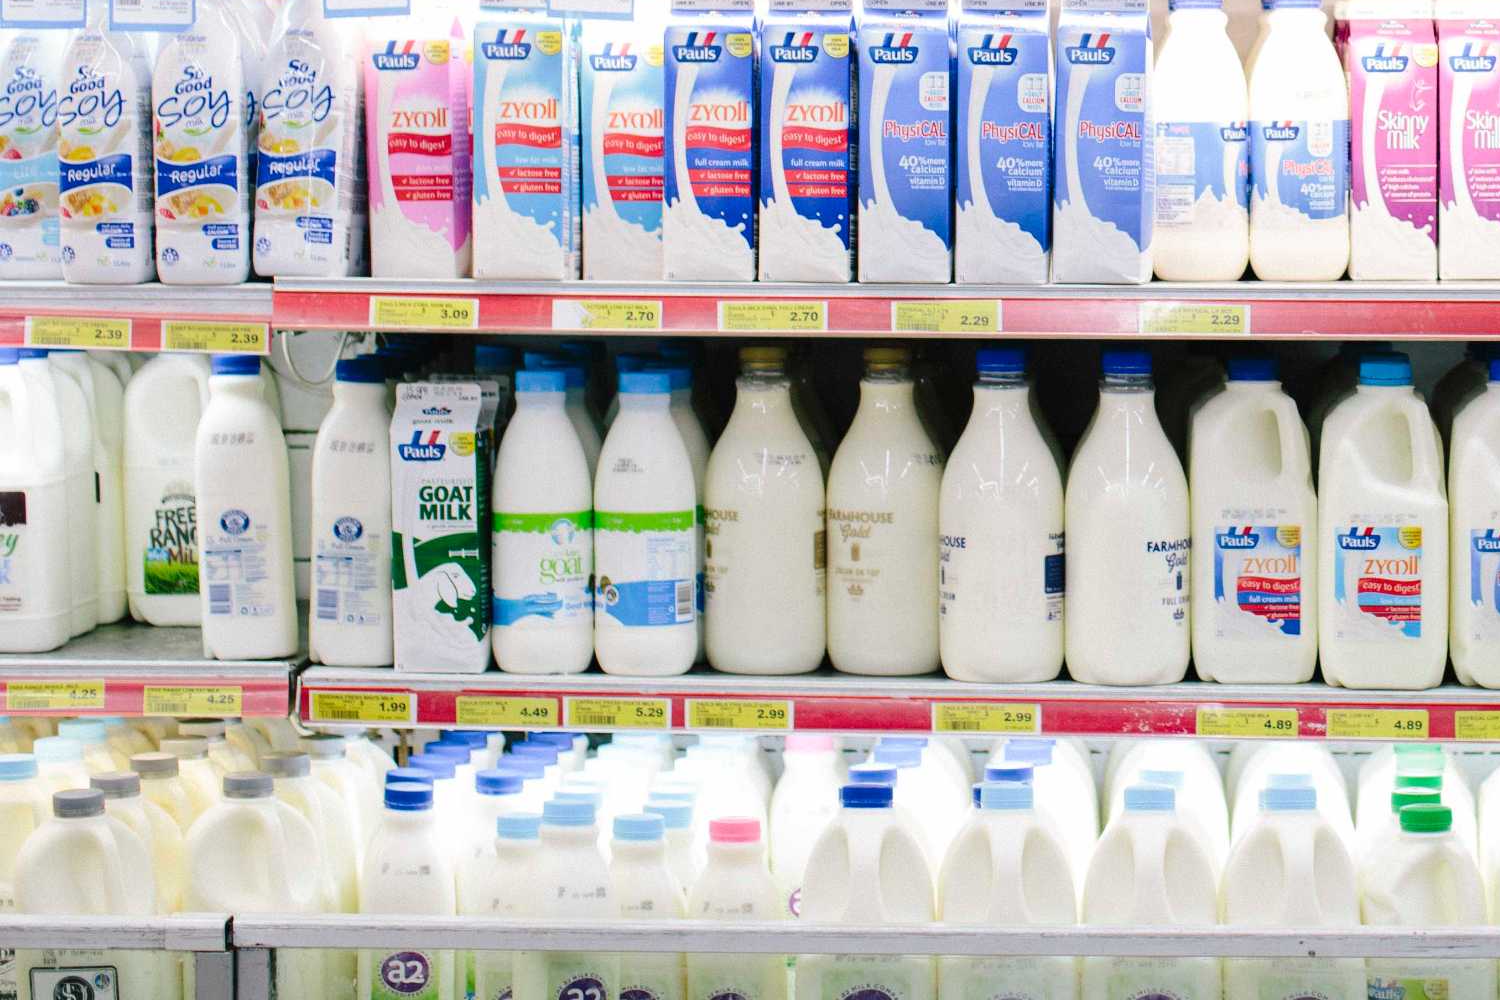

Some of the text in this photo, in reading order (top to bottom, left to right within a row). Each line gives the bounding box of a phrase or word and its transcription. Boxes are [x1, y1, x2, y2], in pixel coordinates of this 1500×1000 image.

[175, 78, 212, 95] Good
[1378, 108, 1429, 134] Skinny
[884, 121, 946, 140] PhysiCAL
[1079, 121, 1141, 141] PhysiCAL
[1386, 127, 1421, 150] Milk
[694, 158, 706, 167] full
[731, 158, 748, 166] milk
[68, 164, 116, 182] Regular
[171, 165, 222, 184] Regular
[441, 309, 468, 320] 3.09
[626, 310, 654, 322] 2.70
[790, 311, 818, 322] 2.70
[1211, 314, 1240, 325] 2.29
[960, 315, 989, 326] 2.29
[95, 328, 123, 340] 2.39
[230, 333, 259, 344] 2.39
[419, 486, 472, 503] GOAT
[419, 505, 472, 521] MILK
[1221, 535, 1255, 548] Pauls
[69, 689, 97, 699] 4.25
[208, 694, 235, 704] 4.25
[379, 702, 406, 713] 1.99
[520, 707, 549, 718] 4.49
[636, 707, 664, 718] 5.29
[757, 709, 785, 720] 2.99
[1004, 711, 1032, 722] 2.99
[1264, 719, 1292, 730] 4.89
[1394, 719, 1422, 730] 4.89
[383, 959, 425, 984] a2
